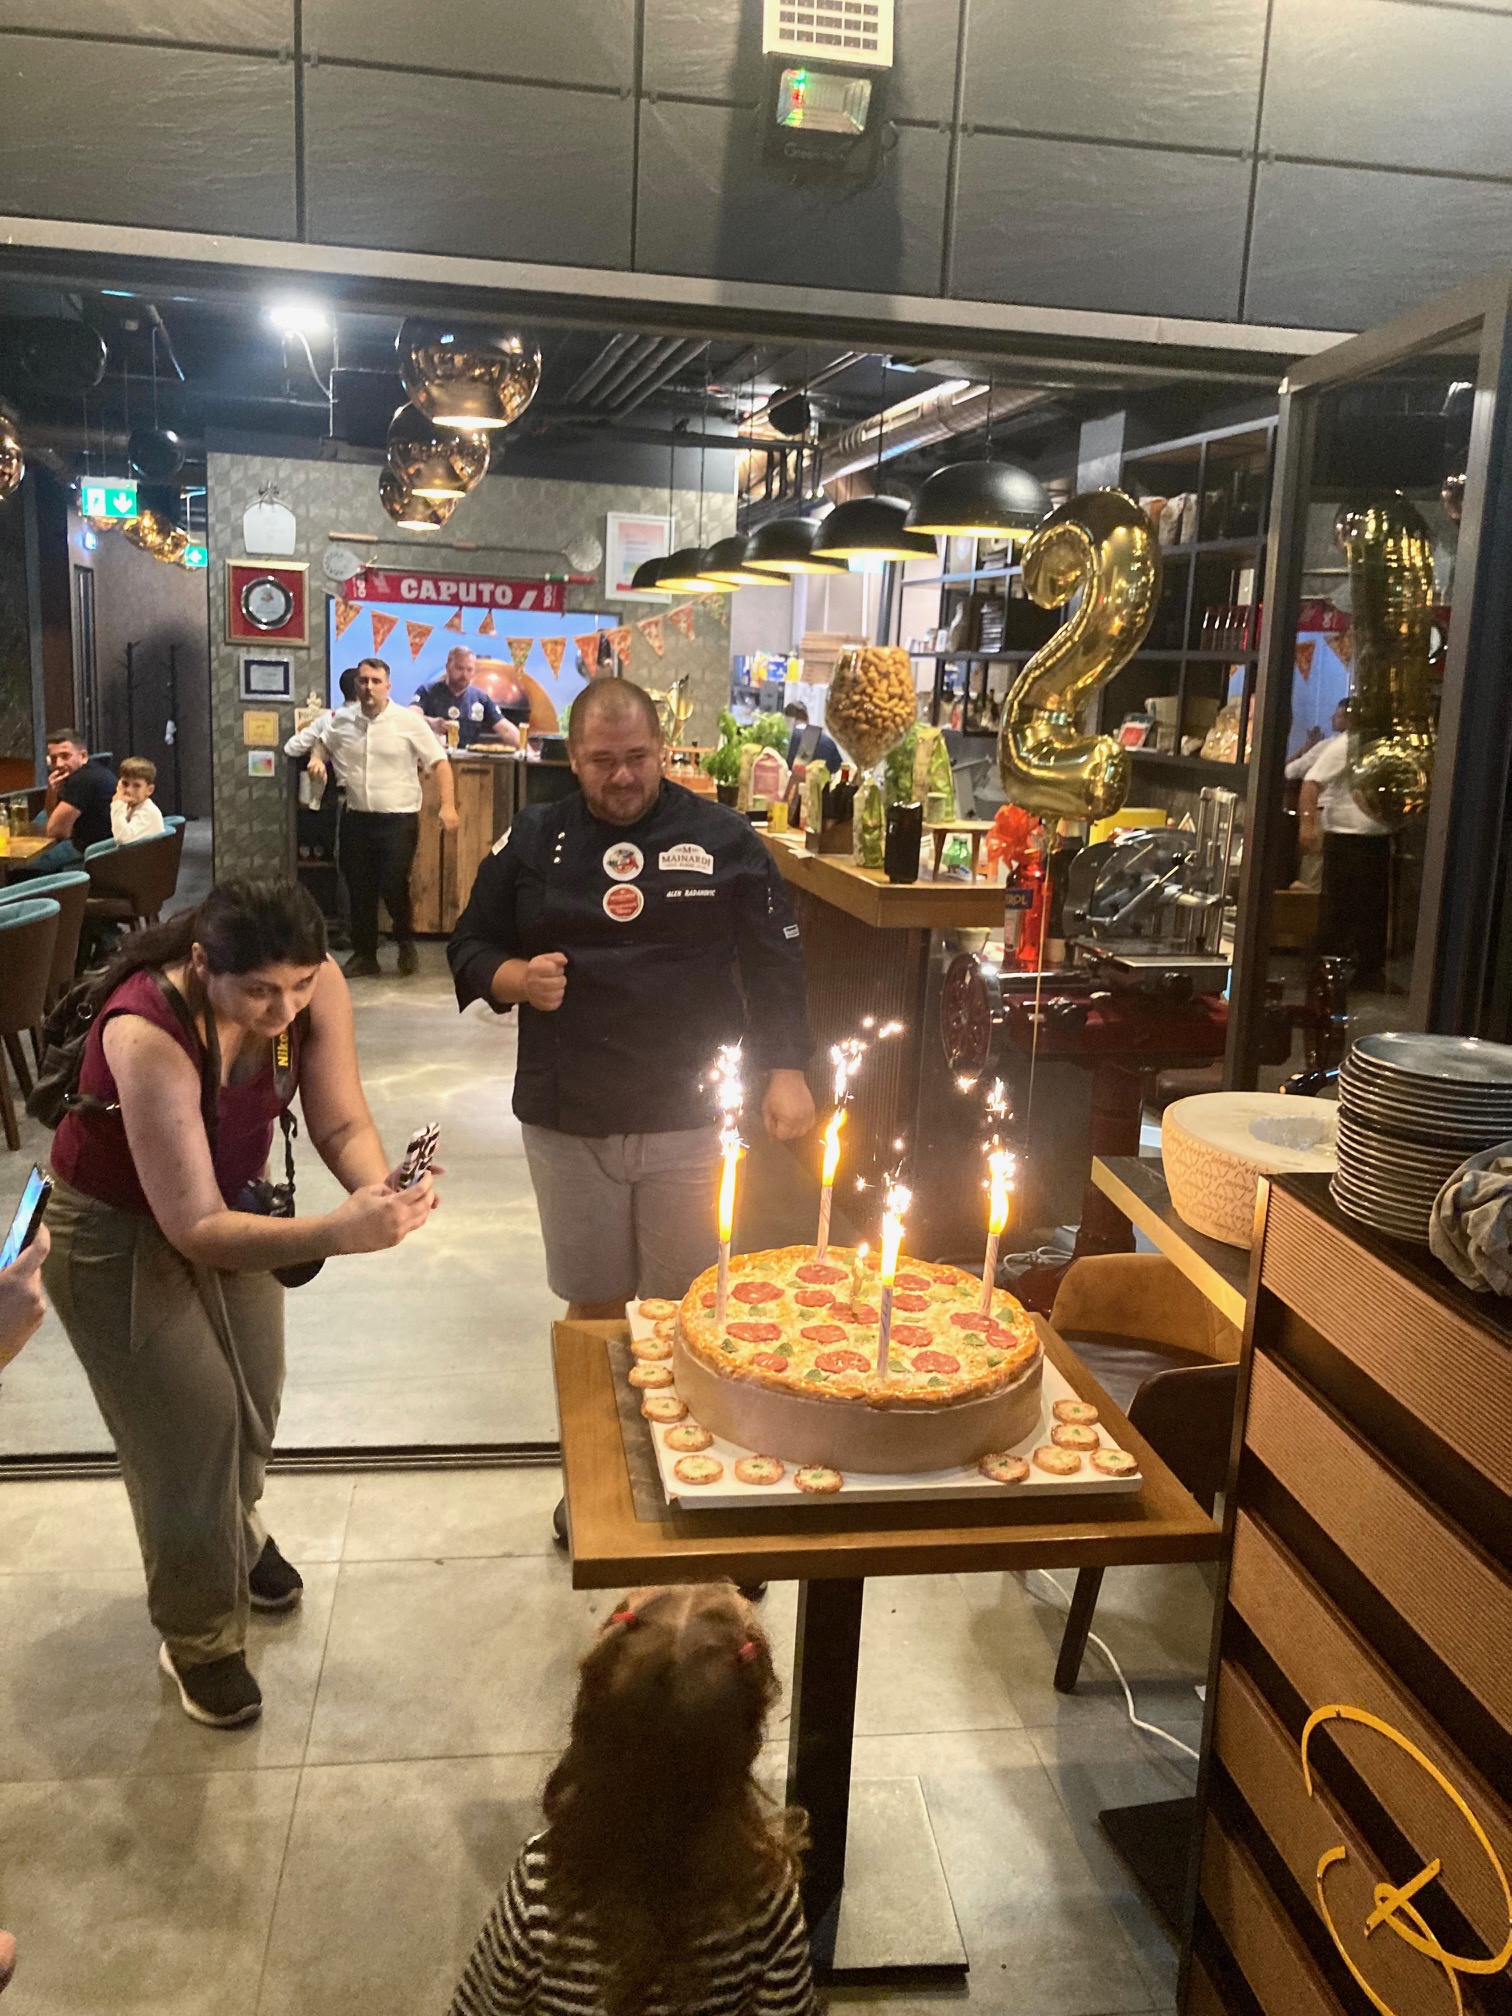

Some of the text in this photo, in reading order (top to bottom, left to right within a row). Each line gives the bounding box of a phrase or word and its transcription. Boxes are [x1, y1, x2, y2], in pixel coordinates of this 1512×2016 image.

[400, 578, 513, 606] CAPUTO
[998, 487, 1161, 820] 2
[662, 855, 711, 866] MAINARDI
[277, 1032, 289, 1066] Niko
